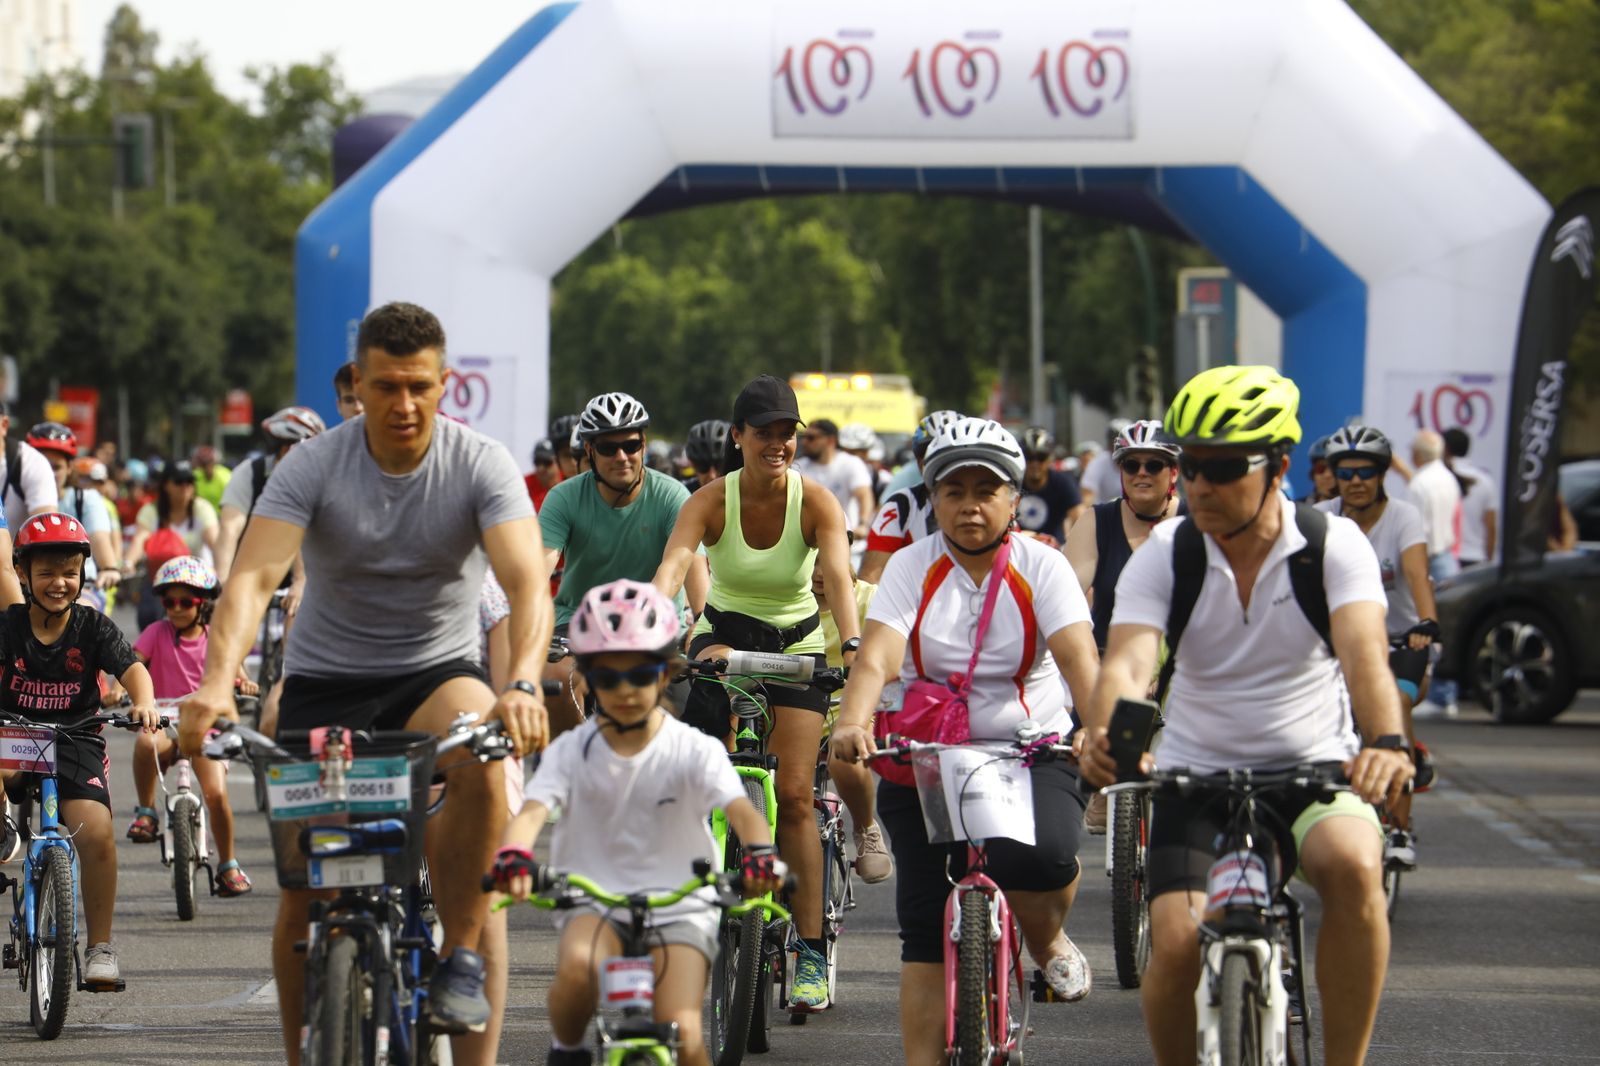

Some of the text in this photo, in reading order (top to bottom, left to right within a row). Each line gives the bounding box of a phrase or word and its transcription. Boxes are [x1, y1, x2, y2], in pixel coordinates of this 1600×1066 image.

[761, 662, 785, 671] 00416
[10, 675, 81, 696] Emirates
[18, 694, 71, 710] FLY BETTER
[11, 744, 38, 755] 00296
[285, 785, 325, 801] 0061
[349, 782, 396, 796] 00618
